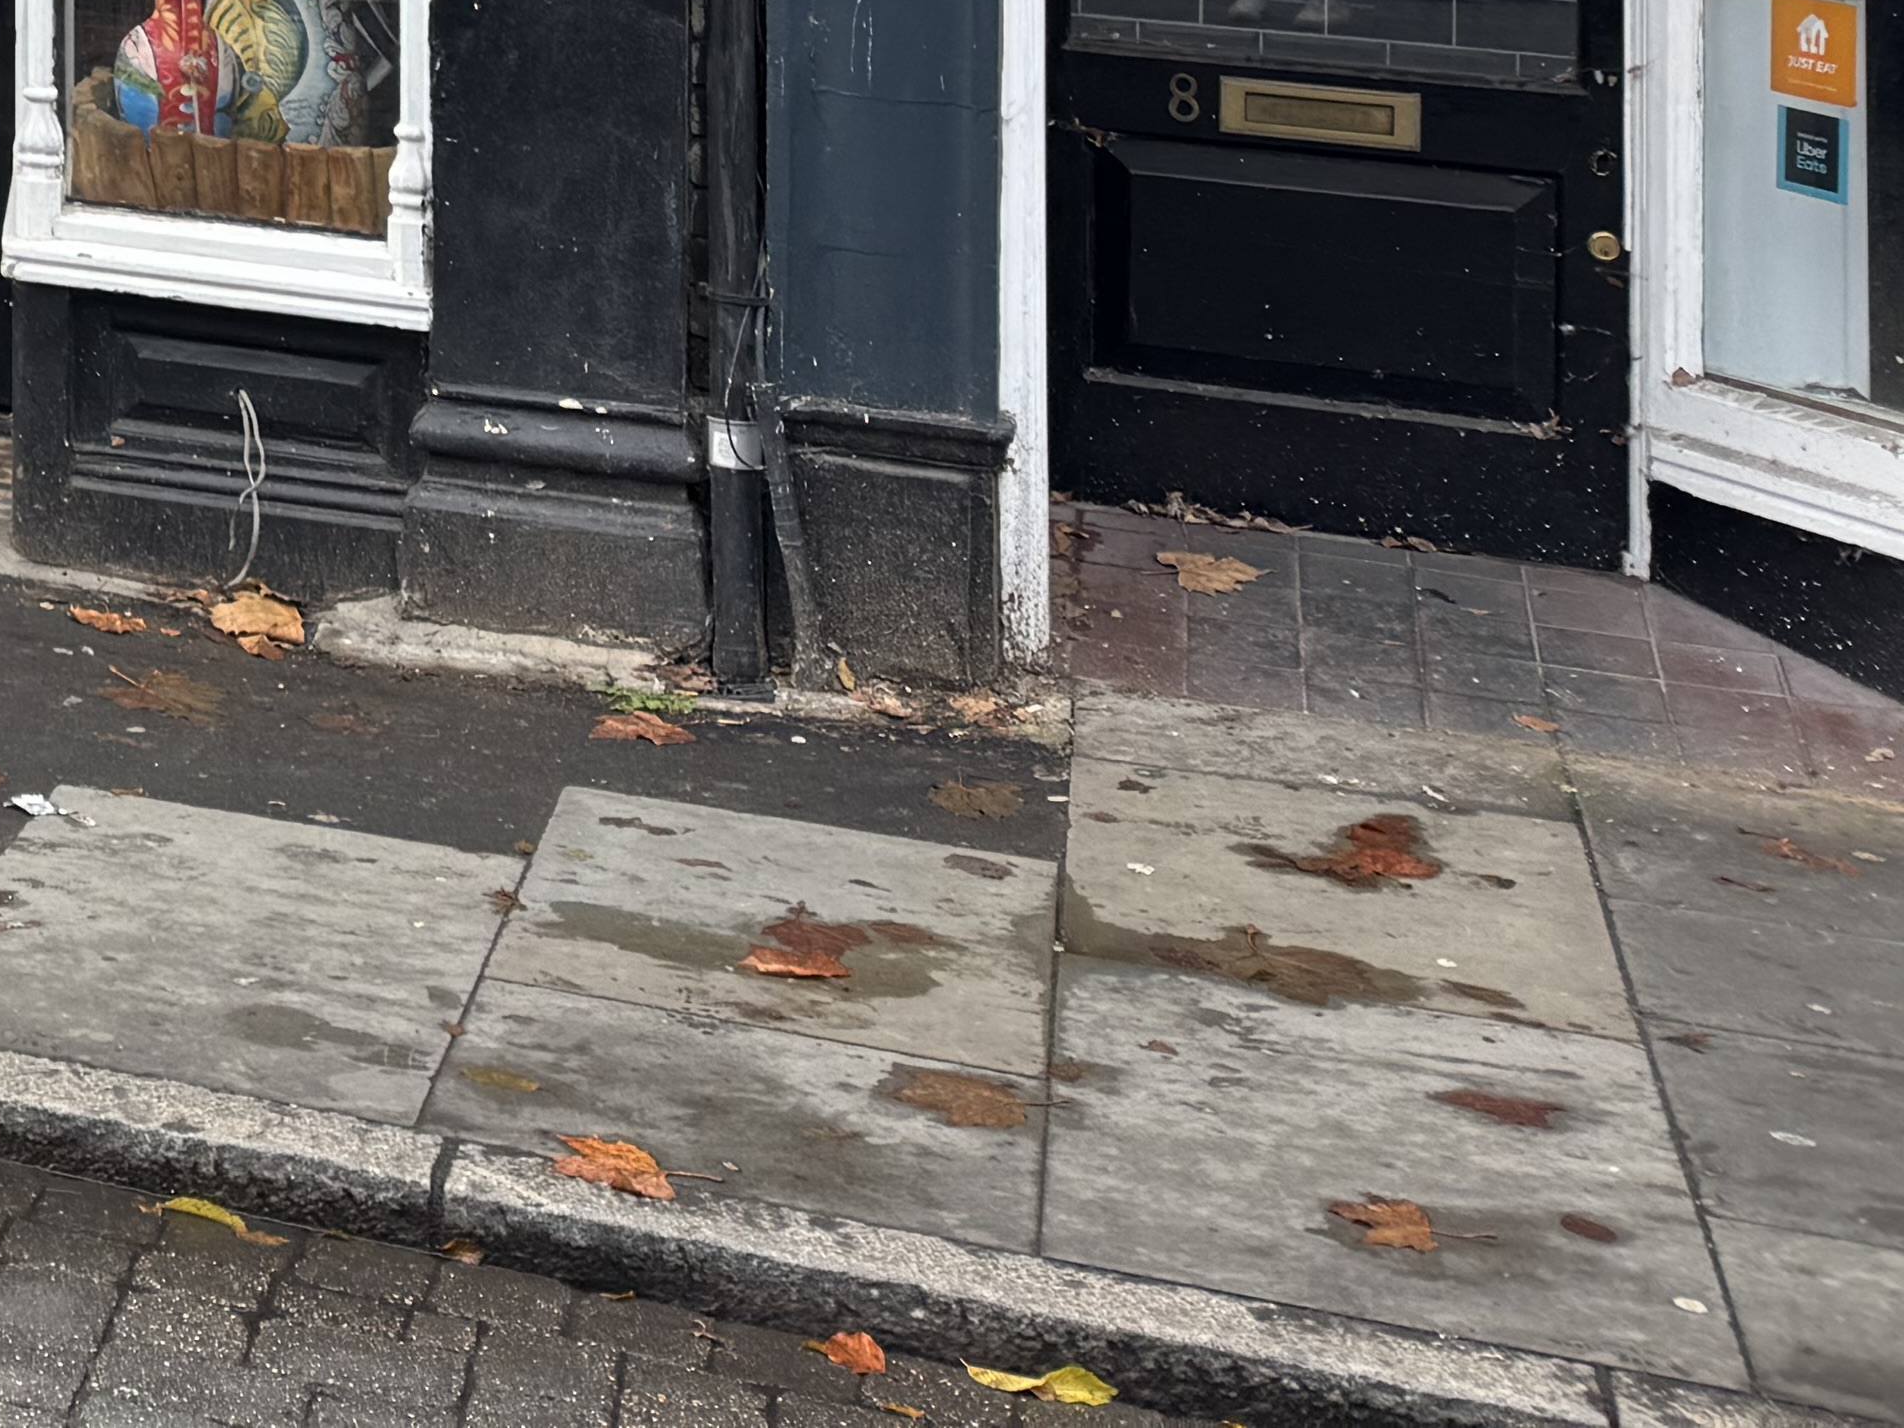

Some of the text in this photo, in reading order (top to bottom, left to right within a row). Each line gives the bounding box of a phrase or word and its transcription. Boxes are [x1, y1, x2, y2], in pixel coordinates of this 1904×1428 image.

[1787, 55, 1839, 75] JUST EAT
[1167, 72, 1200, 122] 8
[1796, 140, 1828, 159] Uber
[1796, 155, 1828, 174] Eats
